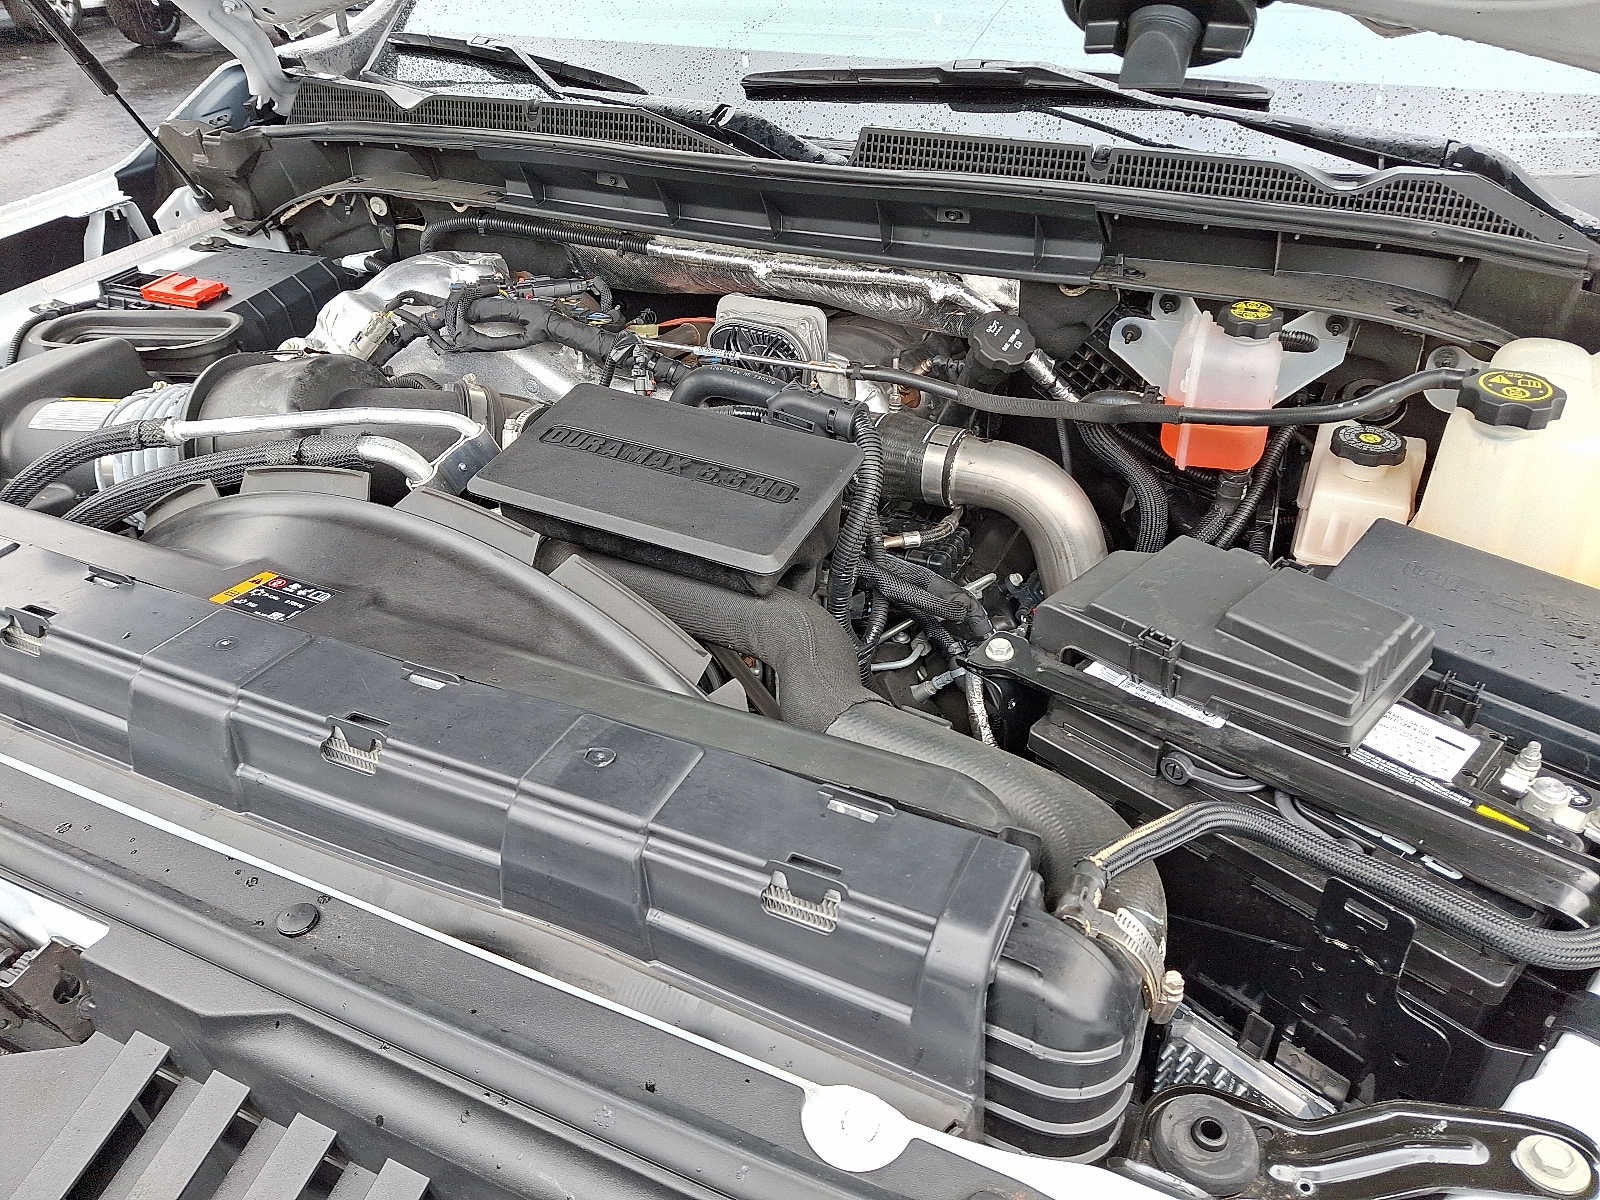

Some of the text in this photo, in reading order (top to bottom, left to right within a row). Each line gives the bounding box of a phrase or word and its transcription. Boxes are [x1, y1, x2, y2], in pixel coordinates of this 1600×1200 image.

[543, 427, 796, 502] DURAMAX 6.6 HD
